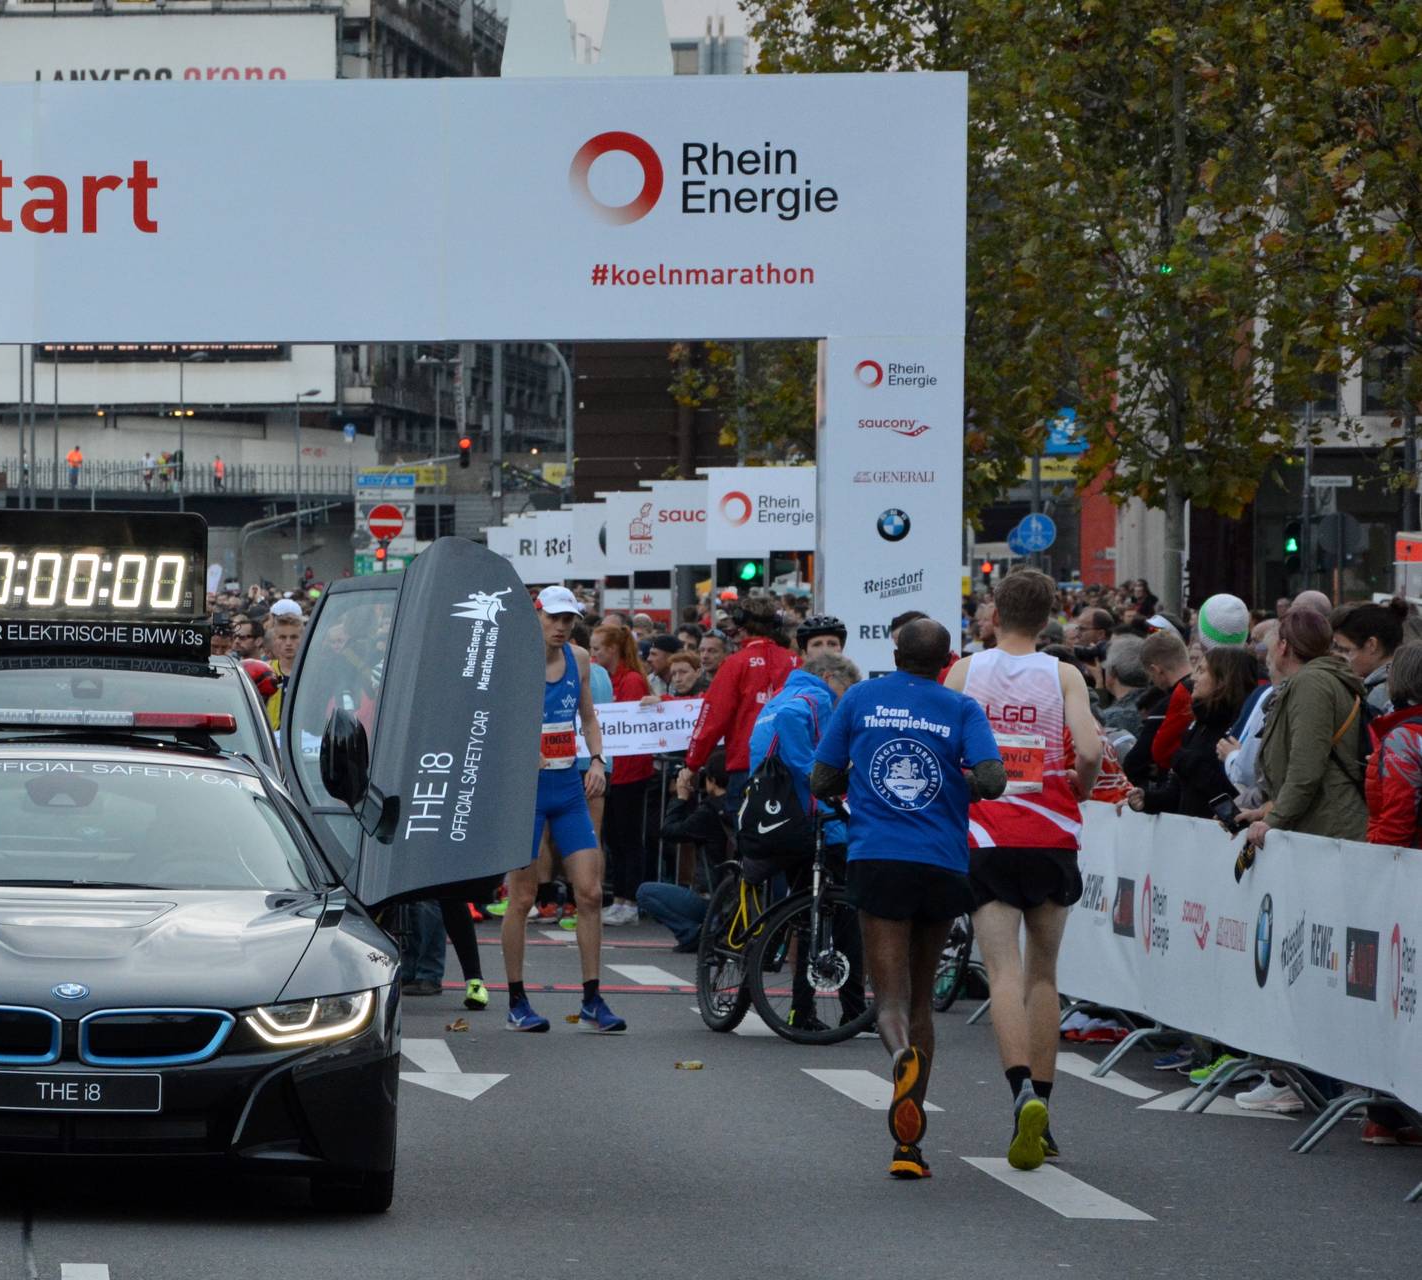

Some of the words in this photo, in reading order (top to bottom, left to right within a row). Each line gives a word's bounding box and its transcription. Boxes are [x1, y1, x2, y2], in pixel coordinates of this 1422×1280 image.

[681, 141, 798, 175] Rhein
[681, 180, 839, 221] Energie
[590, 262, 815, 286] #koelnmarathon
[888, 362, 925, 375] Rhein
[888, 374, 938, 389] Energie
[858, 418, 916, 430] saucony
[873, 471, 935, 483] GENERALI
[757, 494, 801, 510] Rhein
[757, 510, 815, 527] Energie
[863, 568, 925, 594] Reissdorf
[7, 624, 128, 643] ELEKTRISCHE
[132, 627, 177, 644] BMW
[180, 630, 204, 646] i3s
[484, 626, 499, 647] Köln
[462, 620, 485, 677] RheinEnergie
[476, 648, 496, 691] Marathon
[875, 705, 910, 717] Team
[986, 703, 1037, 724] LGO
[470, 710, 490, 736] CAR
[863, 715, 951, 738] Therapieburg
[418, 752, 454, 773] i8
[461, 736, 484, 785] SAFETY
[1001, 751, 1032, 763] avid
[91, 763, 200, 780] SAFETY
[873, 743, 903, 800] LEICHLINGER
[909, 743, 939, 799] TURNVEREIN
[405, 782, 448, 840] THE
[450, 786, 475, 841] OFFICIAL
[1310, 922, 1334, 970] REWE
[35, 1081, 80, 1101] THE
[83, 1082, 101, 1102] i8
